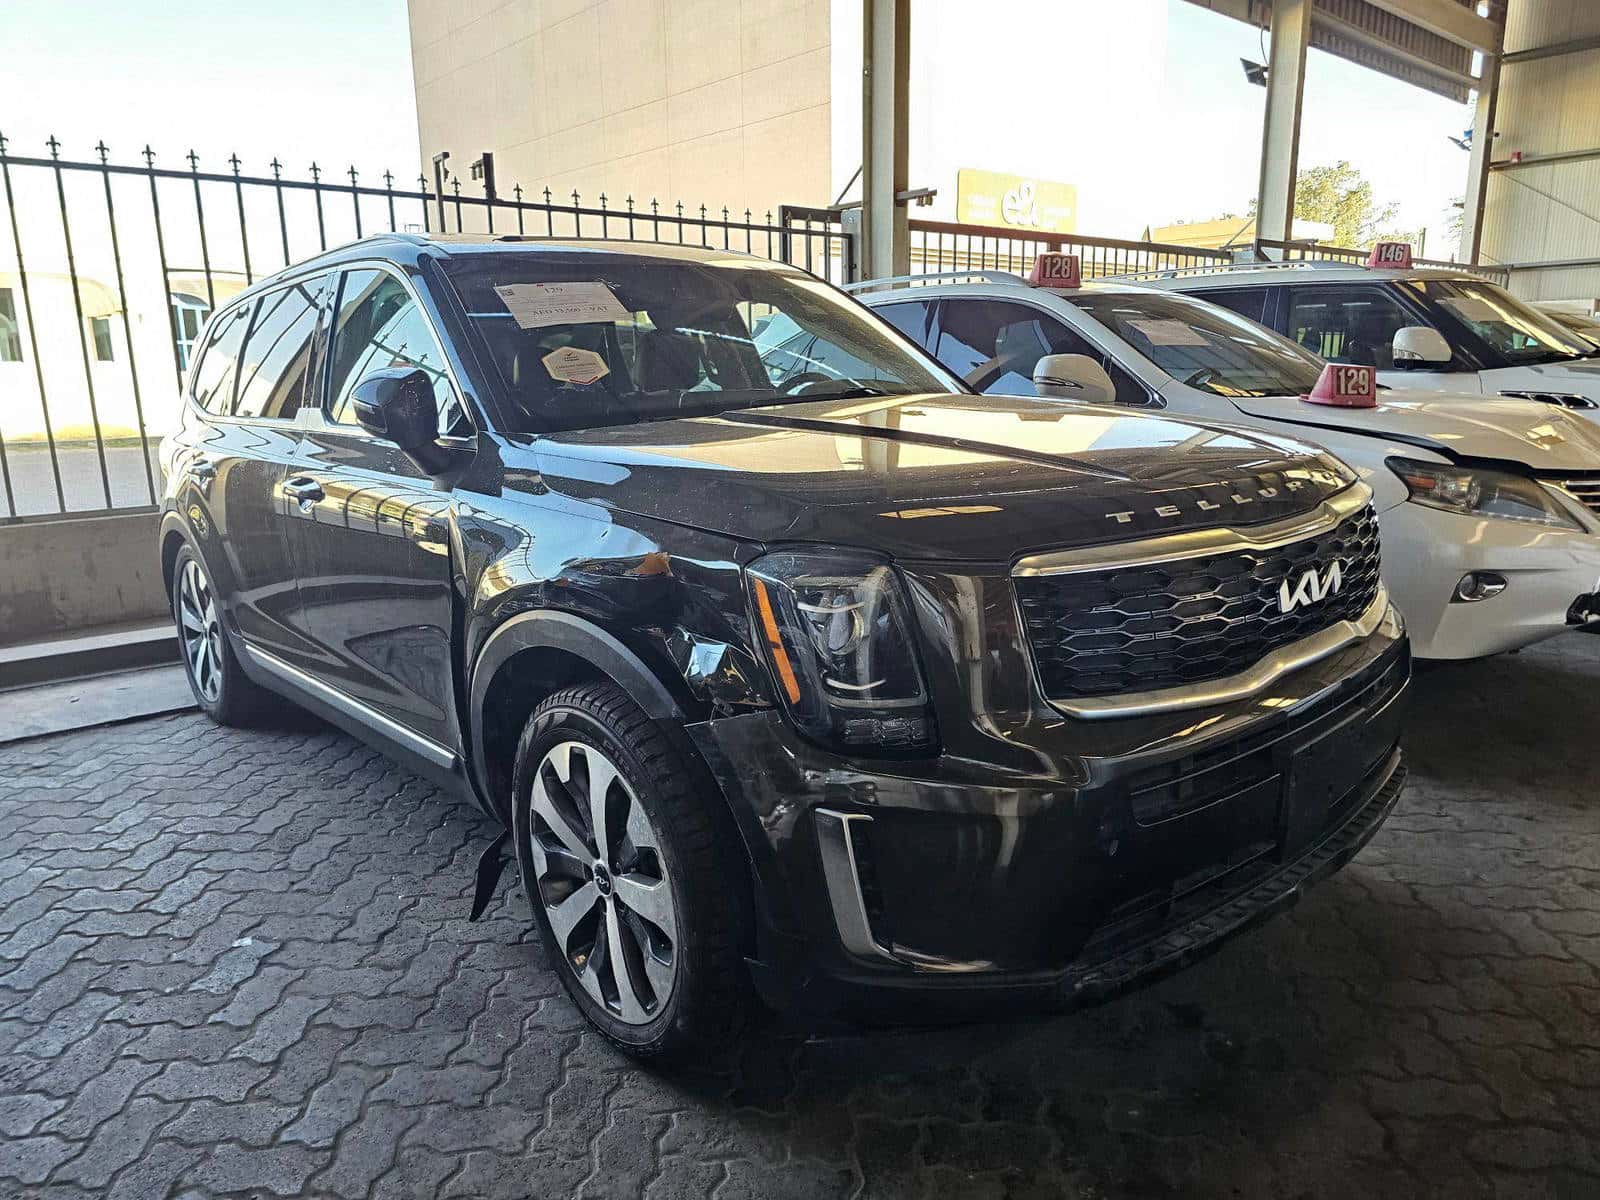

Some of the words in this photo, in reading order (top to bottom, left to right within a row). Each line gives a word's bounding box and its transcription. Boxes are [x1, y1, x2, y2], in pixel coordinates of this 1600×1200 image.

[1381, 245, 1404, 262] 146
[1045, 256, 1071, 279] 128
[1338, 368, 1369, 395] 129
